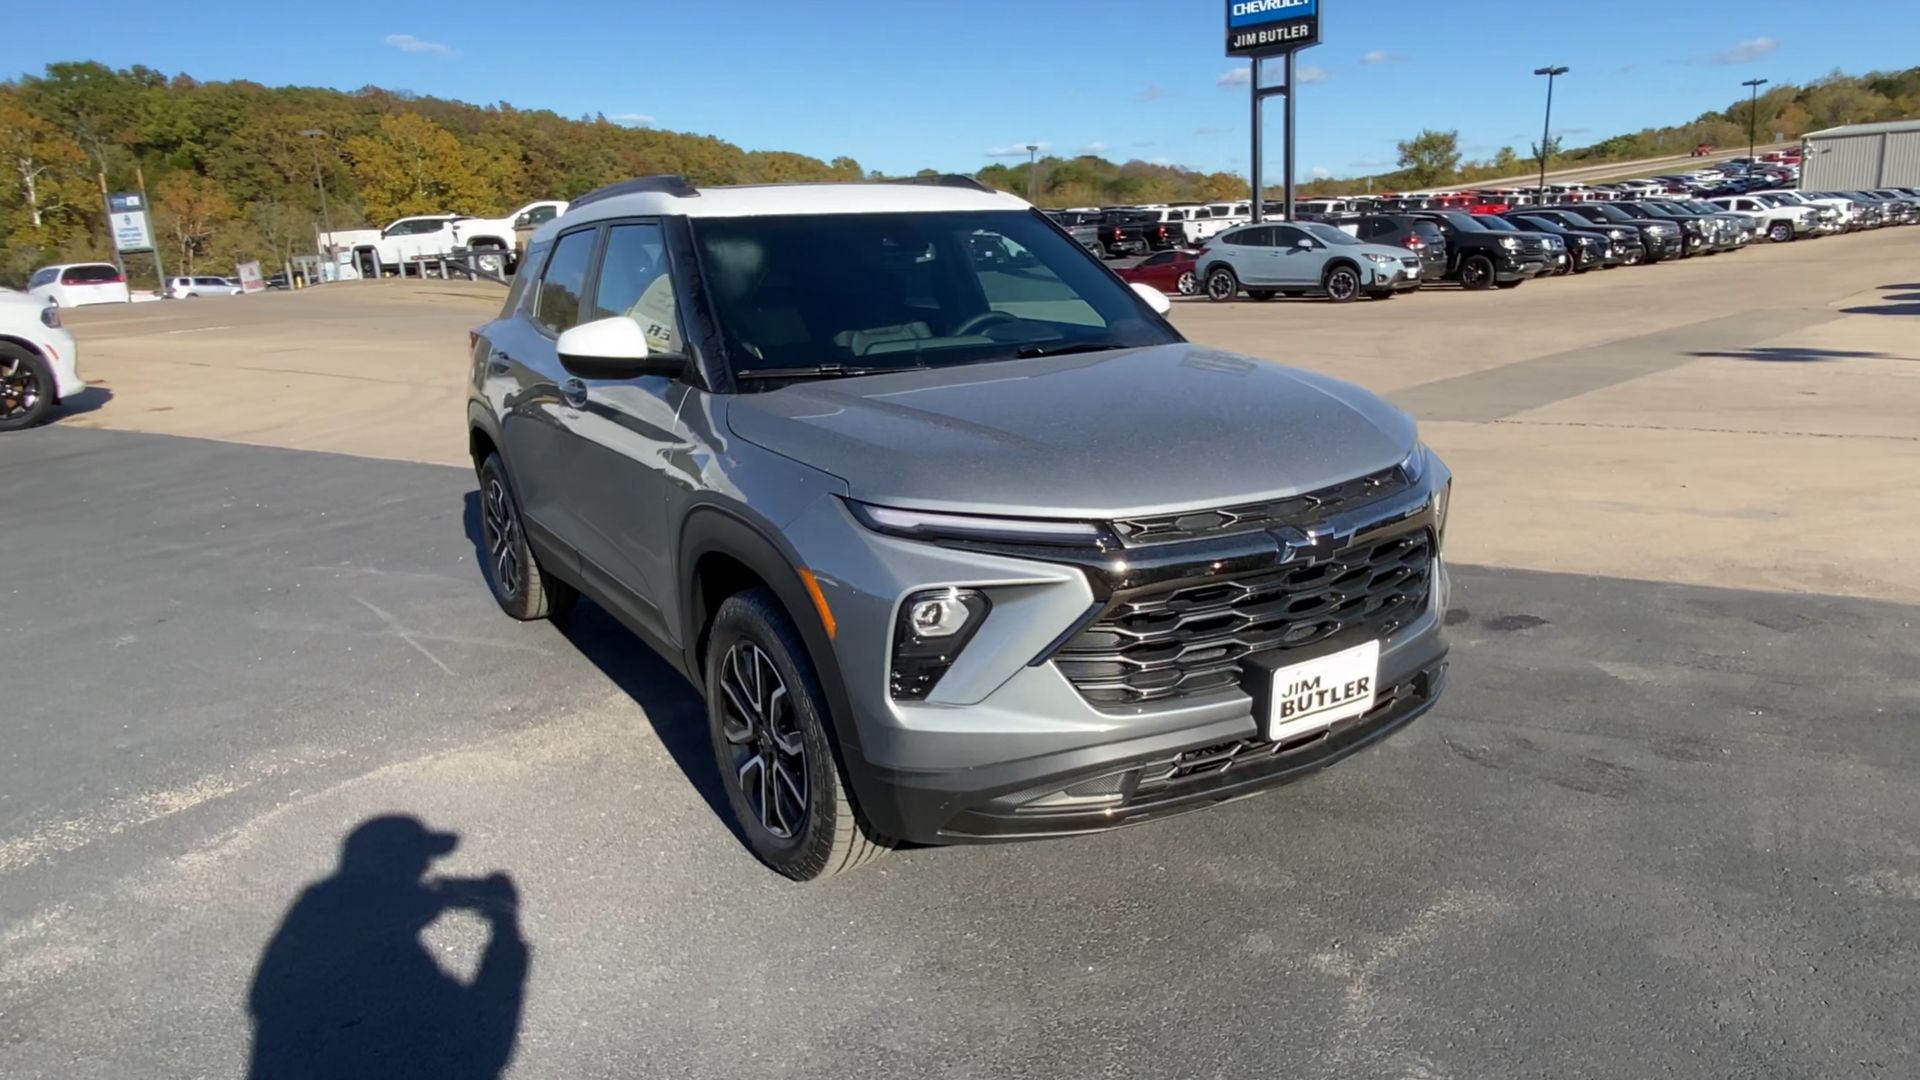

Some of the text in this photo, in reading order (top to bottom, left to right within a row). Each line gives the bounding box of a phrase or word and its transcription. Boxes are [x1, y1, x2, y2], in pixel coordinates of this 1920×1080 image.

[1234, 25, 1309, 48] JIM BUTLER
[1280, 676, 1370, 719] BUTLER
[1281, 675, 1321, 699] JIM
